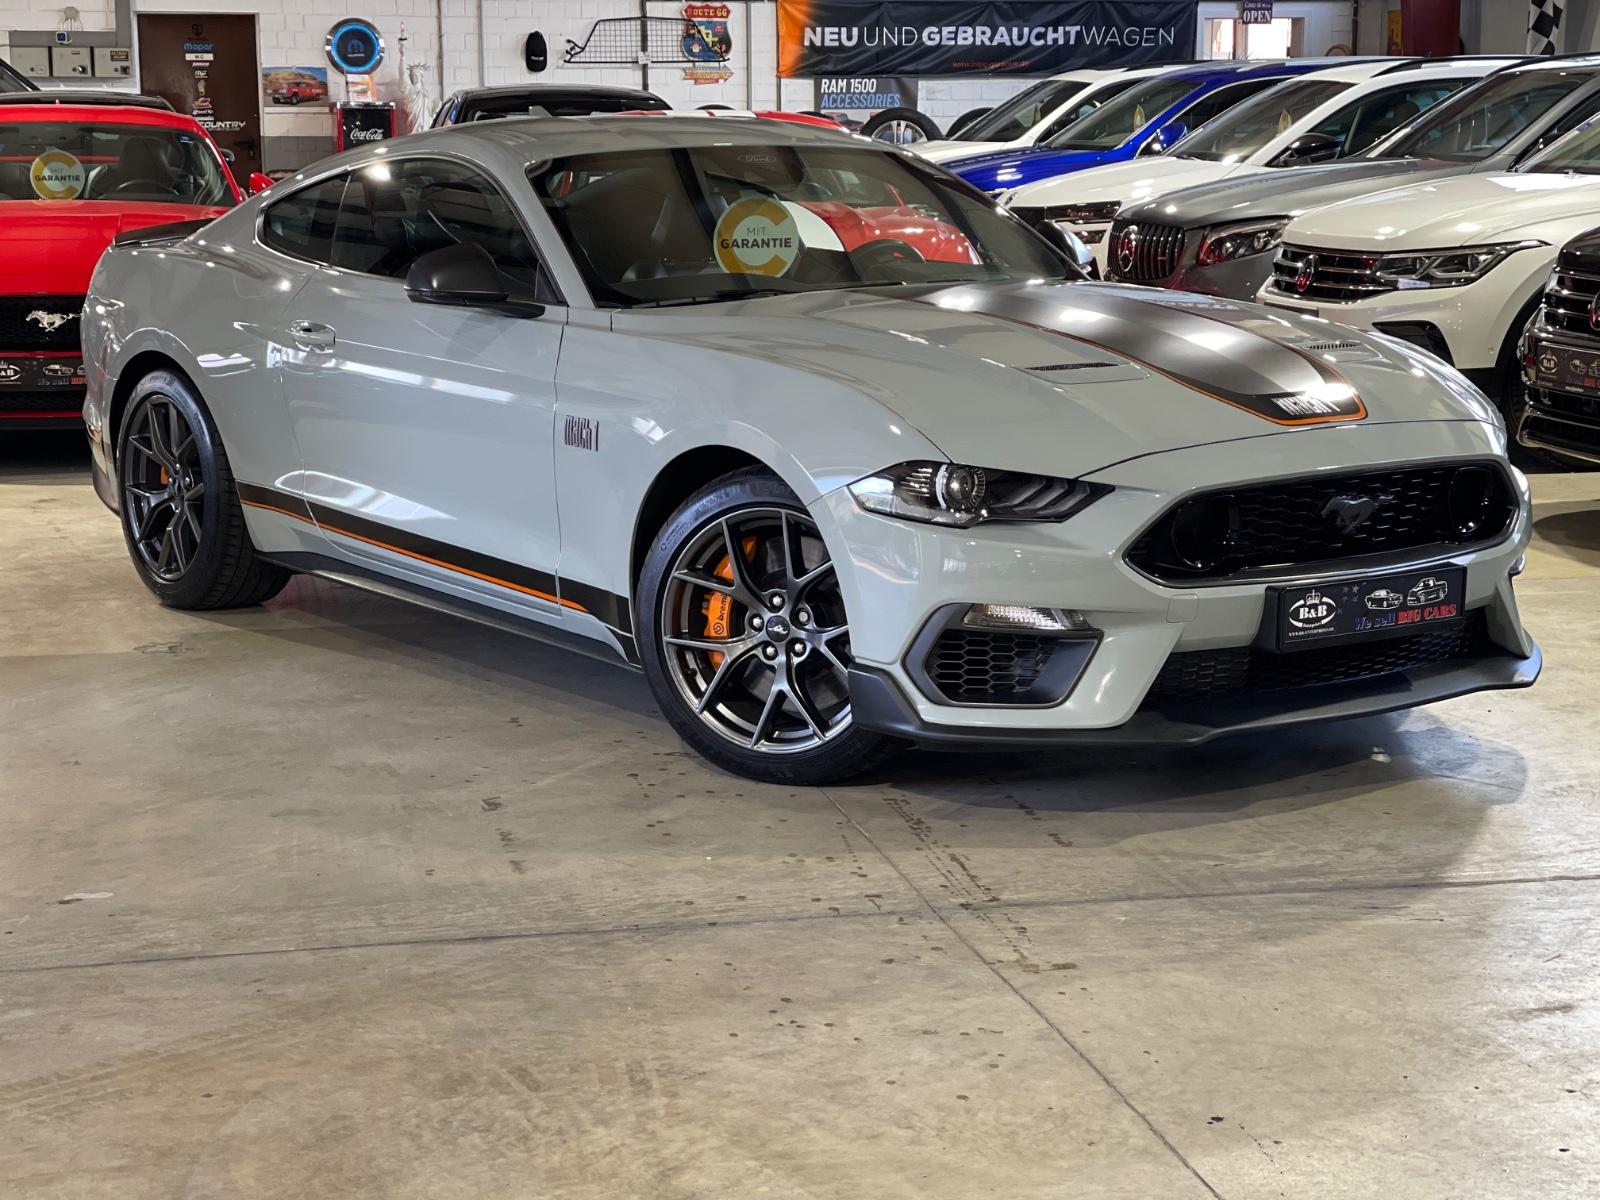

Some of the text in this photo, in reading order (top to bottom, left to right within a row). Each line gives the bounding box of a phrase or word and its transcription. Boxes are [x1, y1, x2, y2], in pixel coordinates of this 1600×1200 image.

[716, 9, 728, 17] 66
[1243, 10, 1271, 23] OPEN
[820, 79, 877, 93] RAM 1500
[820, 93, 901, 108] ACCESSORIES
[746, 227, 767, 236] MIT
[720, 238, 792, 249] GARANTIE
[1299, 605, 1328, 619] B&B
